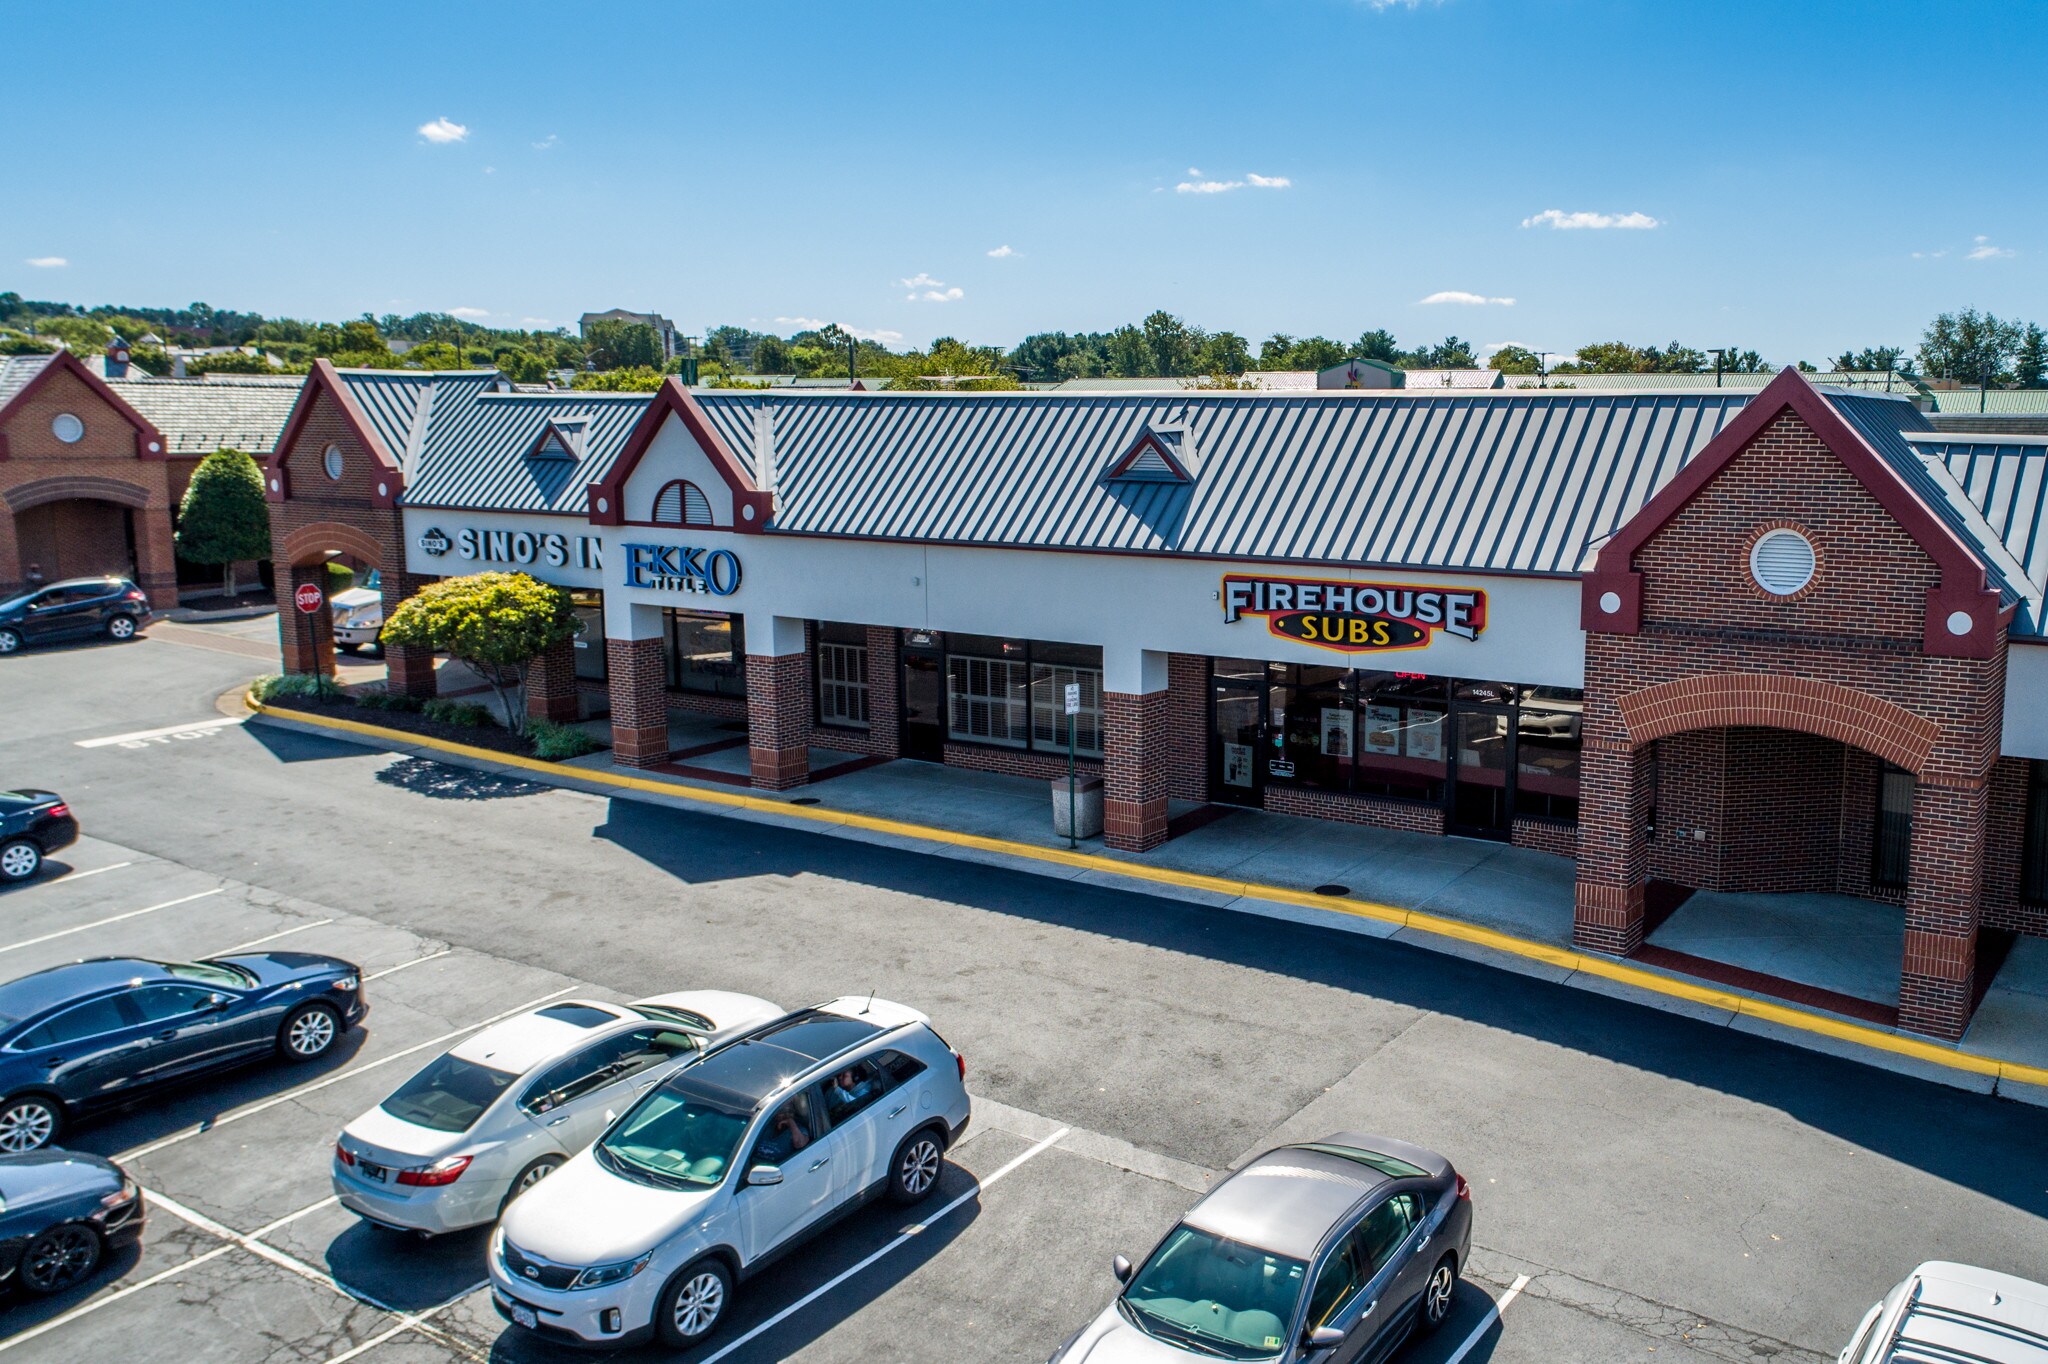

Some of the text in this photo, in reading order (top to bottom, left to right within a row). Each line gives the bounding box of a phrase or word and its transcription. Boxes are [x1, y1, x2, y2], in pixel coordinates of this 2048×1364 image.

[420, 539, 444, 548] SINO'S
[458, 528, 567, 567] SINO'S
[621, 543, 742, 596] EKKO
[652, 576, 708, 594] TITLE
[298, 592, 321, 605] STOP
[1225, 580, 1478, 642] FIREHOUSE
[1301, 615, 1390, 645] SUBS
[117, 727, 223, 749] STOP
